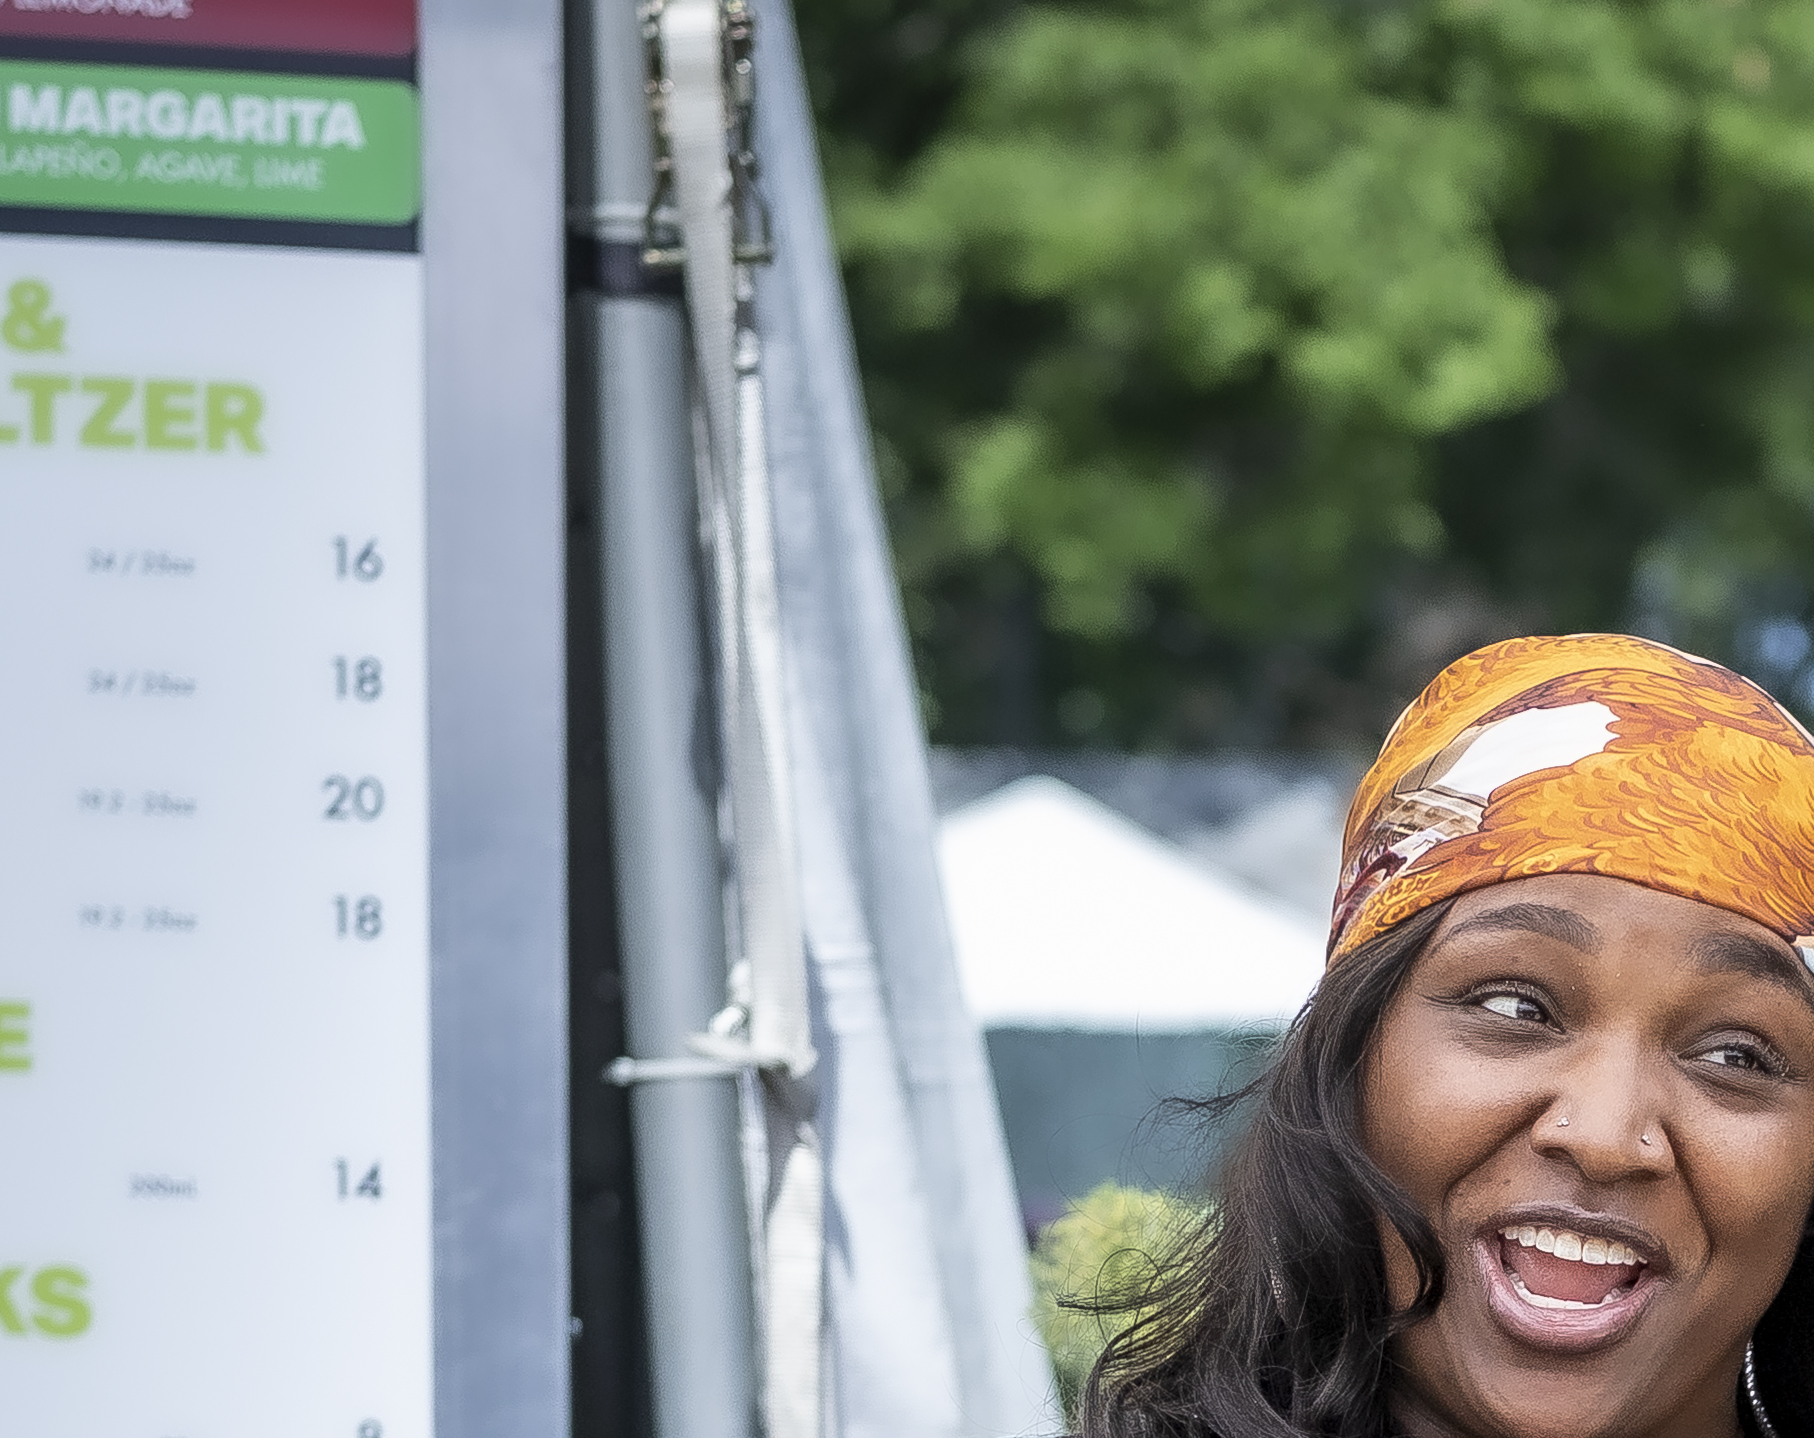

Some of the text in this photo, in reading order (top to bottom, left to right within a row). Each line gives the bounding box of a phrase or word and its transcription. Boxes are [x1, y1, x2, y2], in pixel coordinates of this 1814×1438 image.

[9, 84, 365, 150] MARGARITA
[1, 281, 63, 353] &
[334, 536, 383, 582] 16
[334, 656, 383, 702] 18
[323, 775, 385, 821] 20
[334, 894, 383, 940] 18
[335, 1158, 383, 1201] 14
